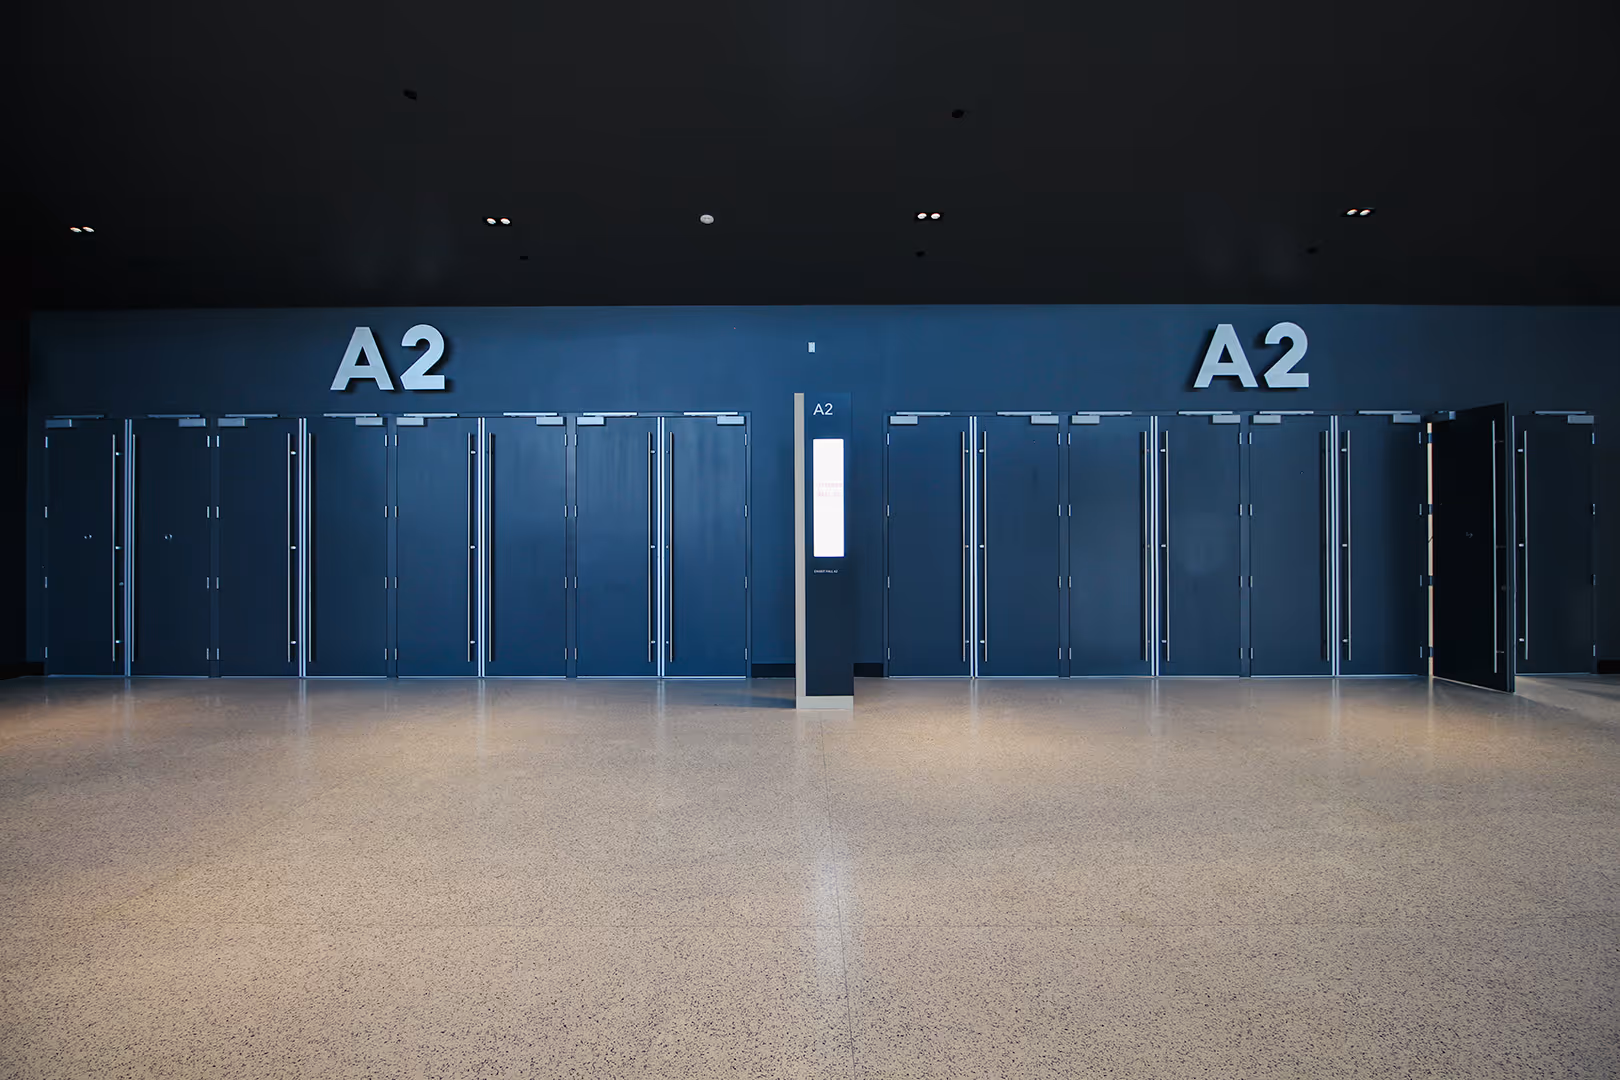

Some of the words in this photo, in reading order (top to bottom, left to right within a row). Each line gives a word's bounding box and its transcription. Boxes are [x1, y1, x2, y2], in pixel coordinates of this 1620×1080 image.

[330, 324, 445, 391] A2
[1193, 321, 1310, 388] A2
[813, 402, 833, 415] A2
